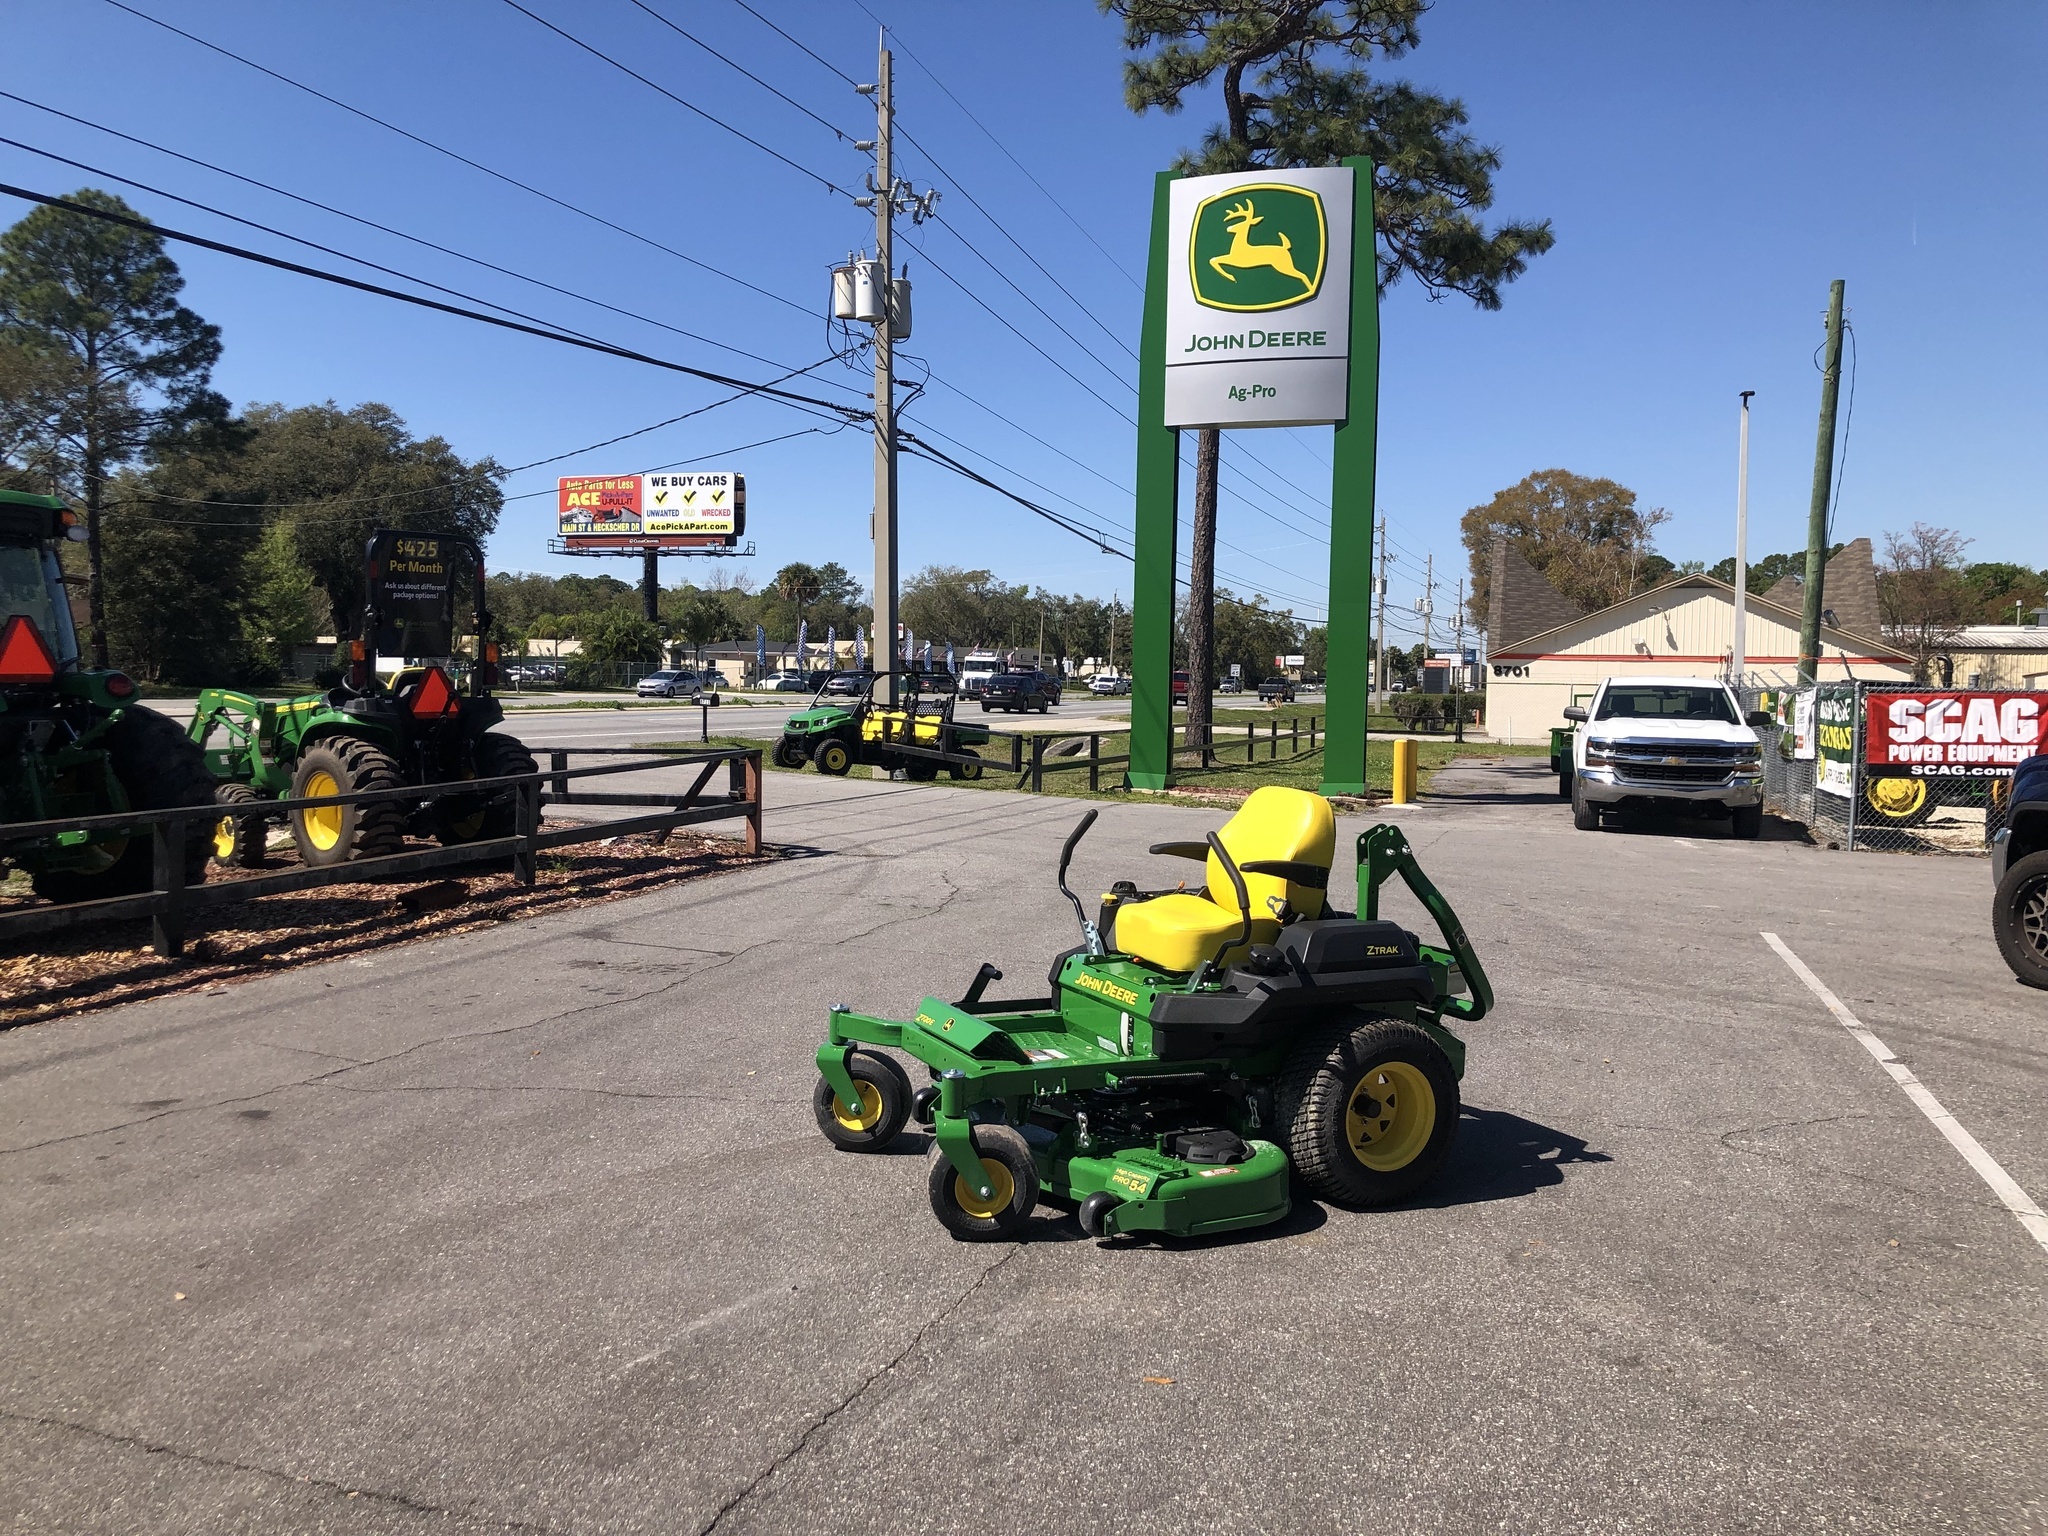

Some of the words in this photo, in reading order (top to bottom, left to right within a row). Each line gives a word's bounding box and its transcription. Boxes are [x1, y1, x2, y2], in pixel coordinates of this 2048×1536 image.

[1184, 334, 1244, 352] JOHN
[1248, 330, 1327, 348] DEERE
[1228, 384, 1276, 401] Ag-Pro
[566, 481, 582, 490] Auto
[584, 480, 603, 490] Parts
[605, 480, 615, 489] for
[618, 479, 634, 489] Less
[651, 477, 667, 486] WE
[671, 476, 693, 486] BUY
[698, 476, 727, 486] CARS
[567, 492, 600, 506] ACE
[562, 524, 577, 532] MAIN
[593, 523, 630, 531] HECKSCHER
[631, 523, 640, 531] DR
[650, 523, 728, 531] AcePickAPart.com
[397, 539, 437, 557] $425
[390, 560, 406, 571] Per
[408, 561, 443, 573] Month
[421, 583, 446, 591] different
[393, 591, 414, 600] package
[415, 592, 439, 600] options!
[1494, 665, 1529, 678] 8701
[1888, 698, 2039, 743] SCAG
[1888, 744, 1943, 762] POWER
[1948, 745, 2039, 763] EQUIPMENT
[1911, 765, 2014, 776] SCAG.com
[1366, 945, 1399, 955] ZTRAK
[1074, 971, 1103, 992] JOHN
[1101, 980, 1139, 1006] DEERE
[1112, 1174, 1130, 1185] PRO
[1129, 1180, 1147, 1194] 54
